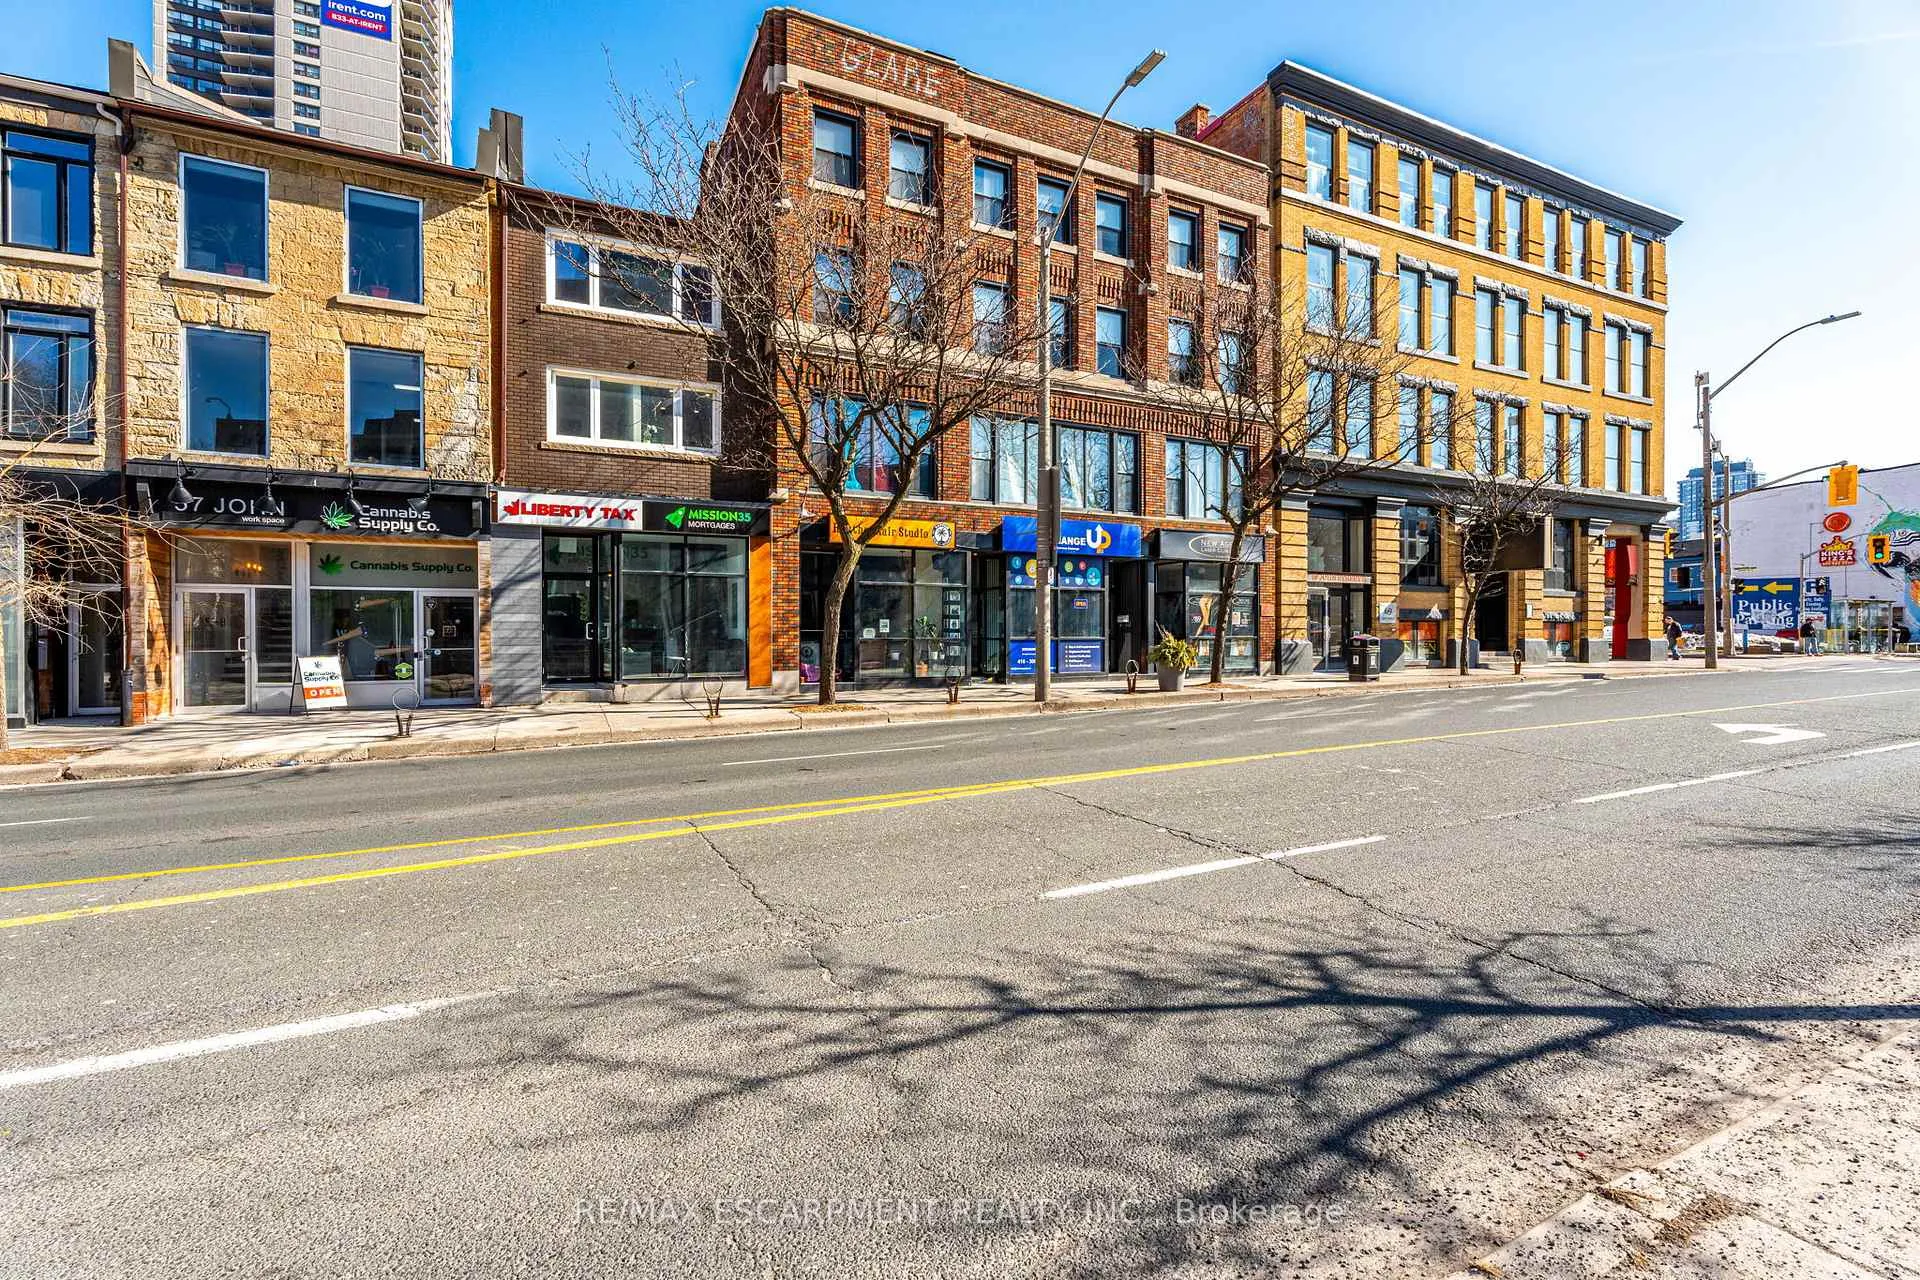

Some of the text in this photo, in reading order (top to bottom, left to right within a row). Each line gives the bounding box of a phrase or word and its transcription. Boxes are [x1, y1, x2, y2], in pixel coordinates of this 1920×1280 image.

[328, 0, 386, 21] irent.com
[520, 502, 638, 521] LIBERTY TAX
[688, 509, 752, 522] MISSION35
[242, 515, 285, 525] work space
[359, 517, 440, 533] Supply Co.
[688, 521, 736, 530] MORTGAGES
[898, 527, 929, 539] Studio
[350, 560, 474, 574] Cannabis Supply Co.
[1737, 599, 1793, 611] Public
